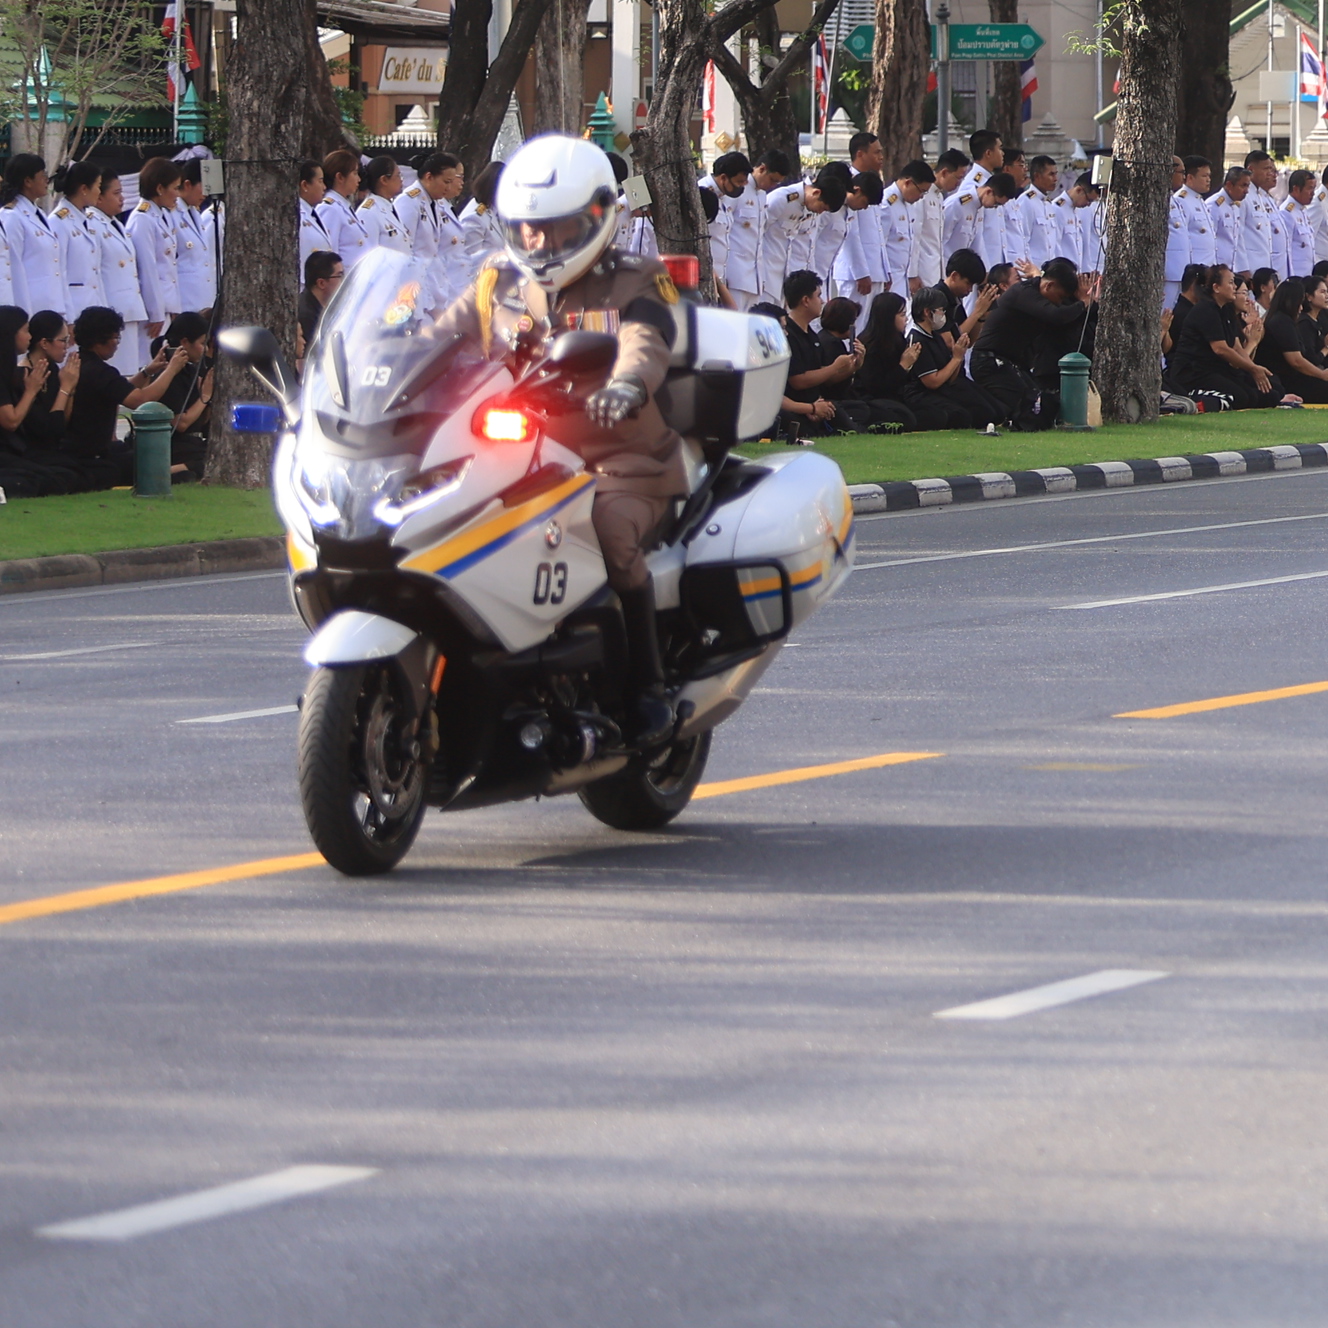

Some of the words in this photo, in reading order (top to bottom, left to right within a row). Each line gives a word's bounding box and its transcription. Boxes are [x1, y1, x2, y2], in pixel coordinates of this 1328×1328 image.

[417, 58, 433, 81] du
[361, 366, 392, 386] 03
[533, 561, 568, 605] 03
